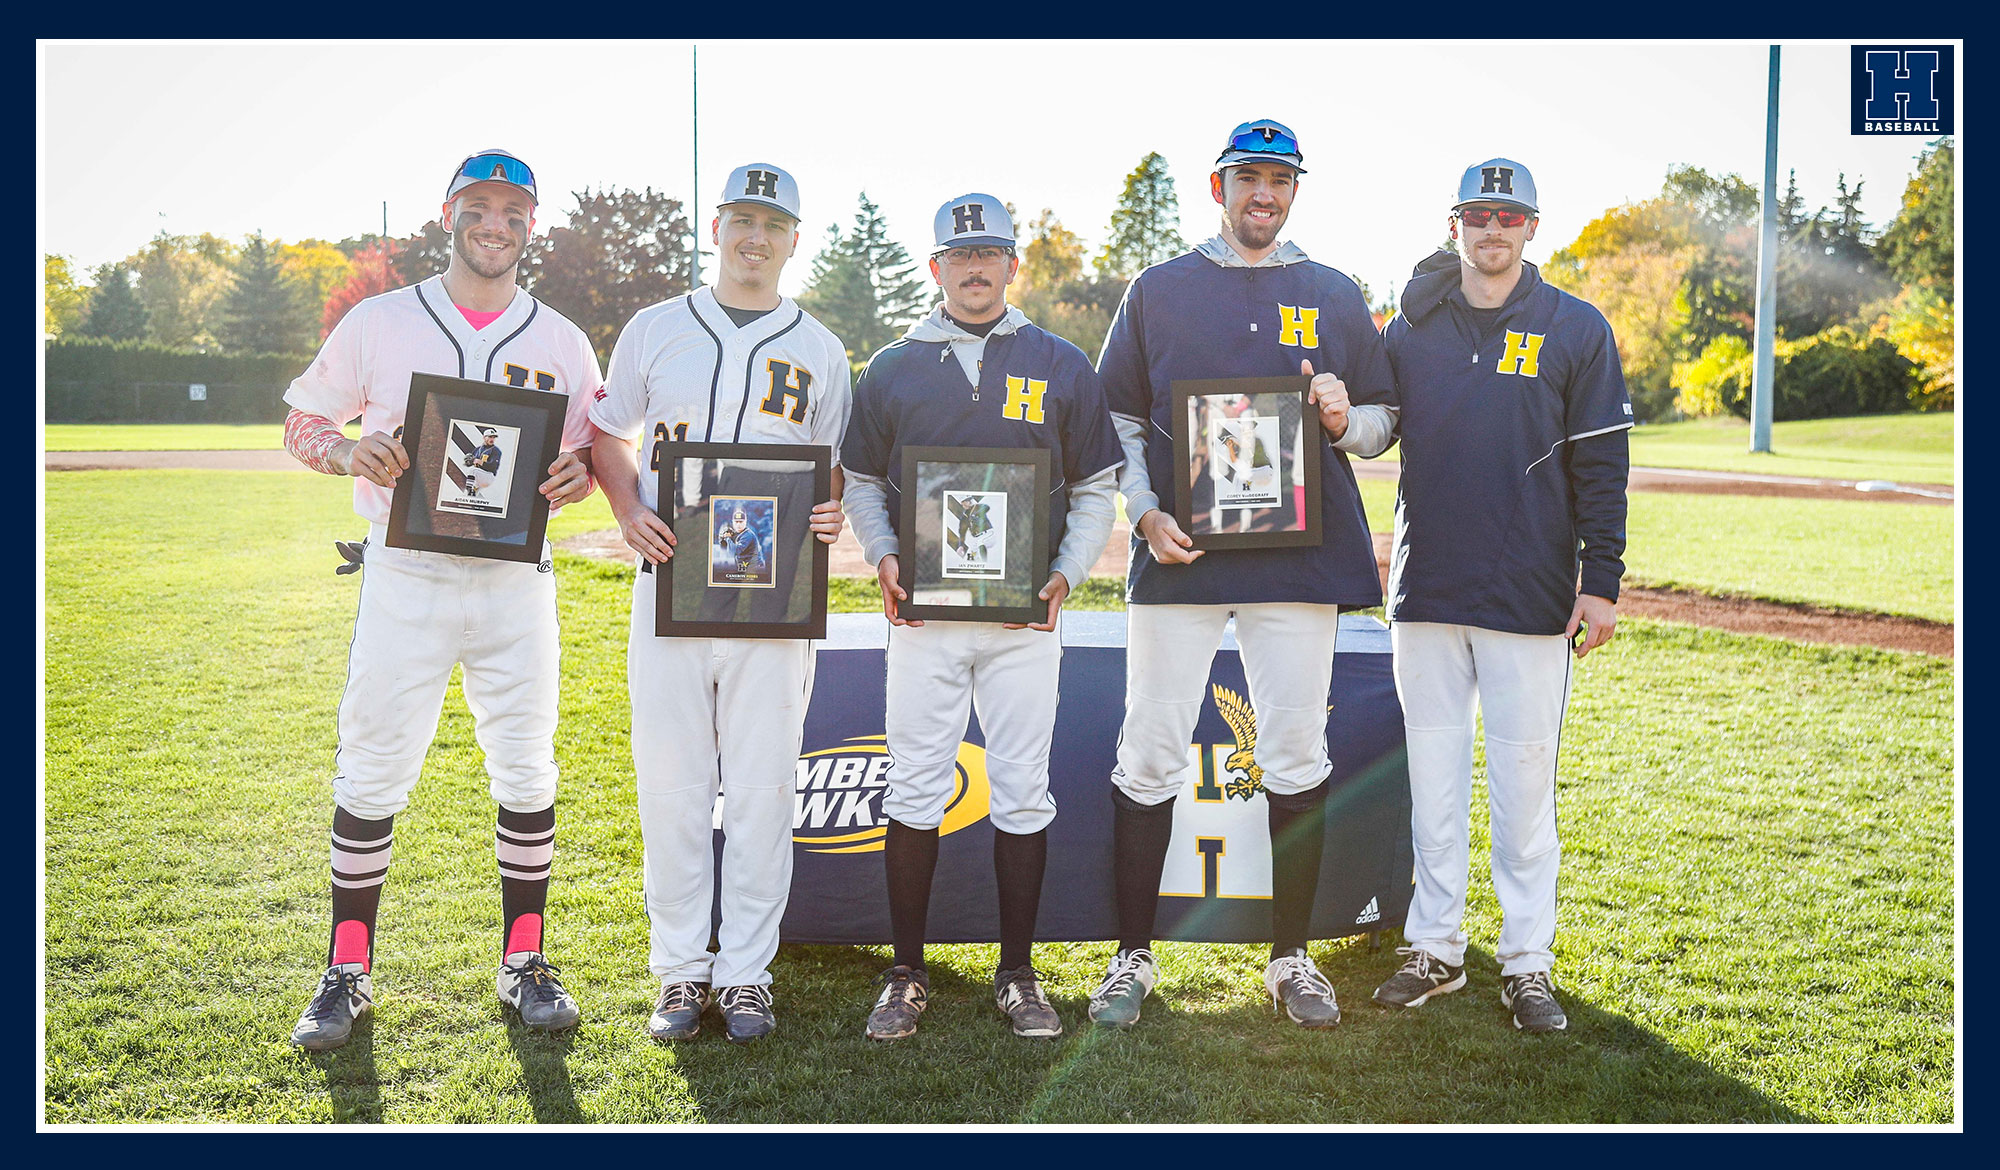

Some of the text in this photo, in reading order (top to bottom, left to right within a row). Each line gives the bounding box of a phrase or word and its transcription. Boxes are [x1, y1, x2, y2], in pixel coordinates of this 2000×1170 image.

[744, 169, 779, 199] H
[1480, 166, 1514, 195] H
[951, 203, 986, 235] H
[1277, 302, 1319, 349] H
[1496, 328, 1546, 377] H
[759, 357, 813, 425] H
[1002, 373, 1049, 424] H
[795, 756, 891, 791] MBE
[1355, 912, 1381, 925] adidas
